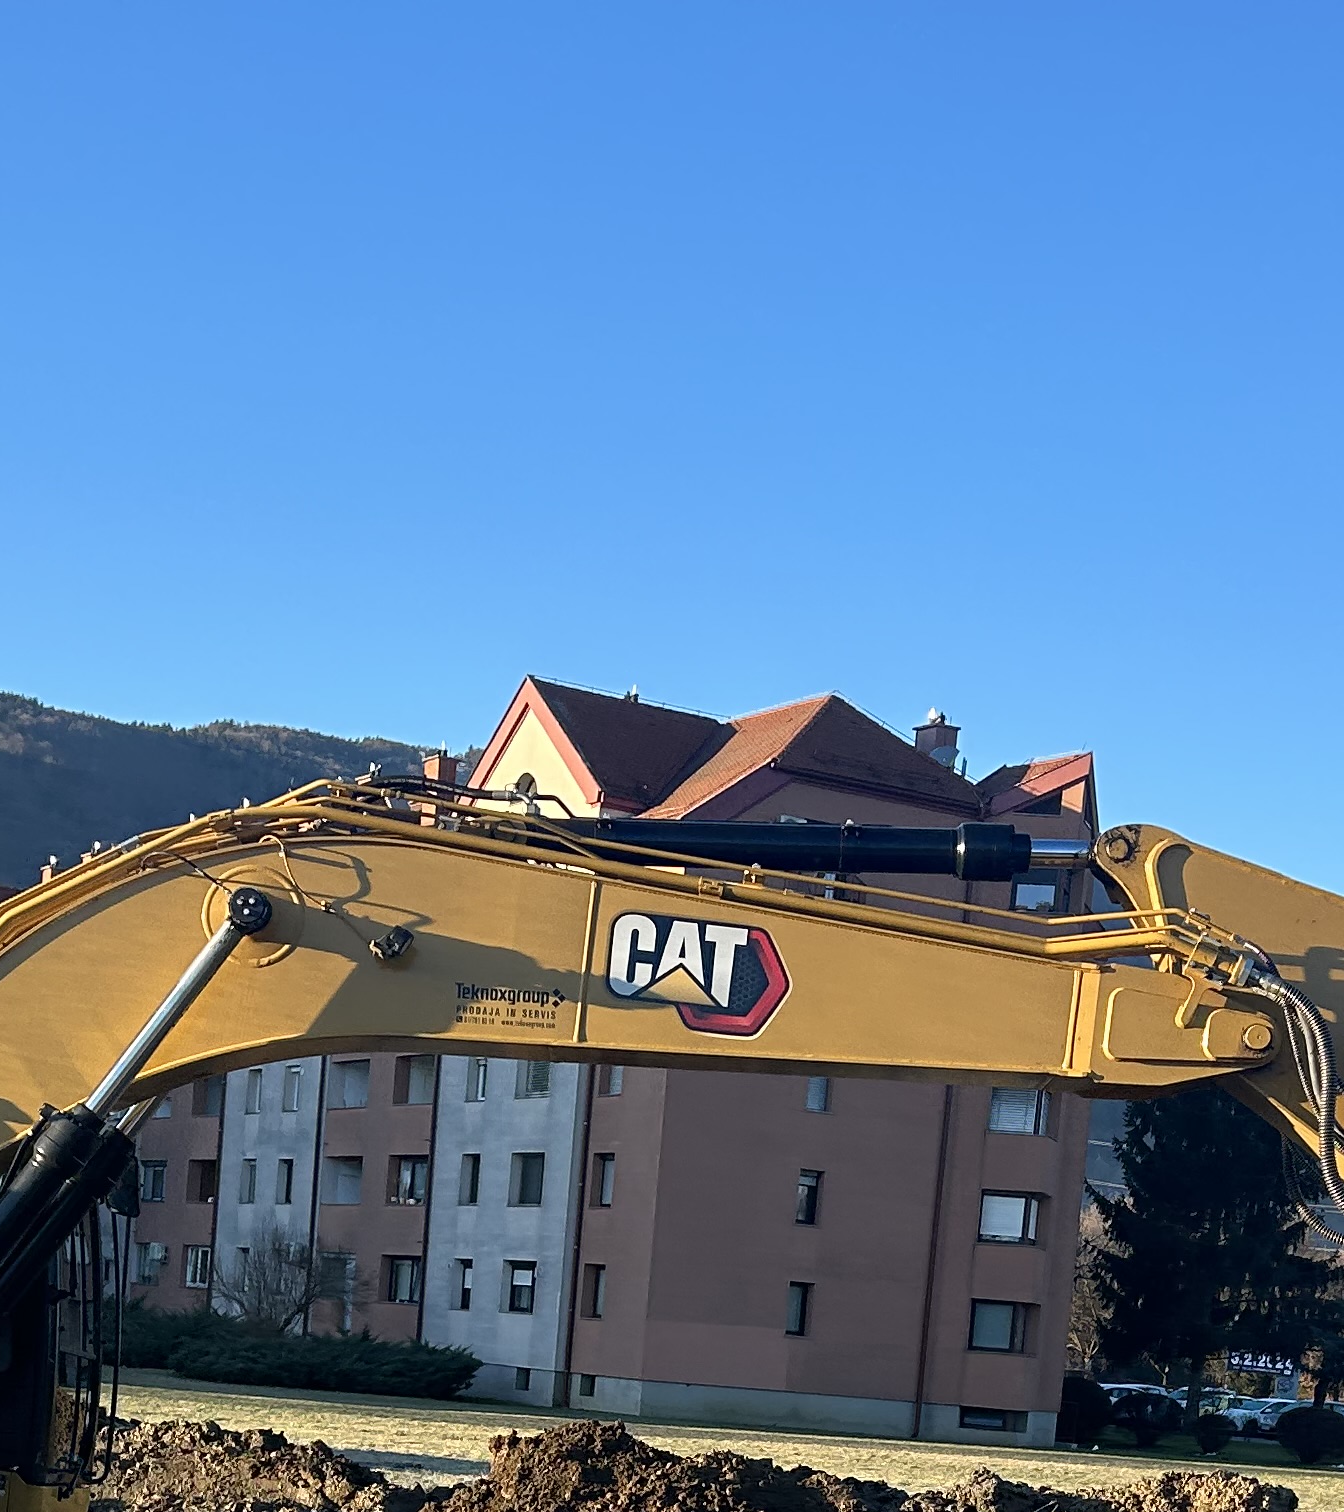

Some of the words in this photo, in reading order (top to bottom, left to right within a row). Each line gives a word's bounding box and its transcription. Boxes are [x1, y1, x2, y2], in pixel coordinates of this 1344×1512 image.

[609, 914, 748, 1007] CAT
[455, 982, 550, 1007] Teknoxgroup
[456, 1005, 500, 1016] PRODAJA
[507, 1008, 516, 1017] IN
[522, 1009, 556, 1019] SERVIS
